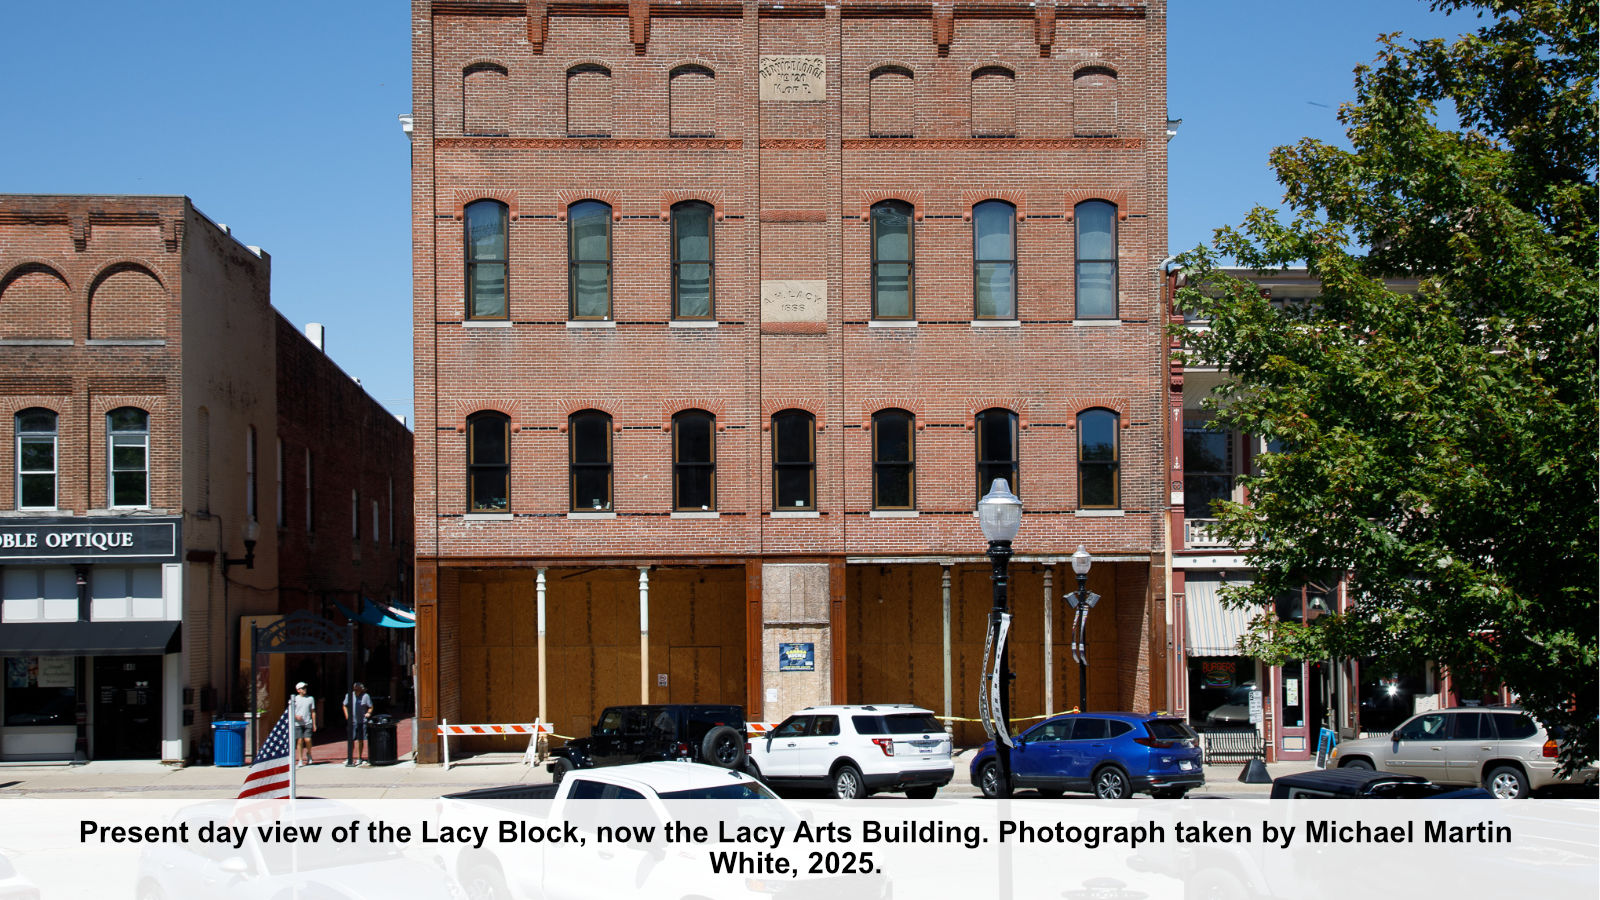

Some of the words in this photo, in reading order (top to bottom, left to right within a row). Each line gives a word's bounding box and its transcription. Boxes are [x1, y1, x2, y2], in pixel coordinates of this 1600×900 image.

[788, 290, 822, 304] LACY
[0, 533, 38, 548] BLE
[45, 531, 134, 550] OPTIQUE
[1202, 661, 1235, 673] BURGERS
